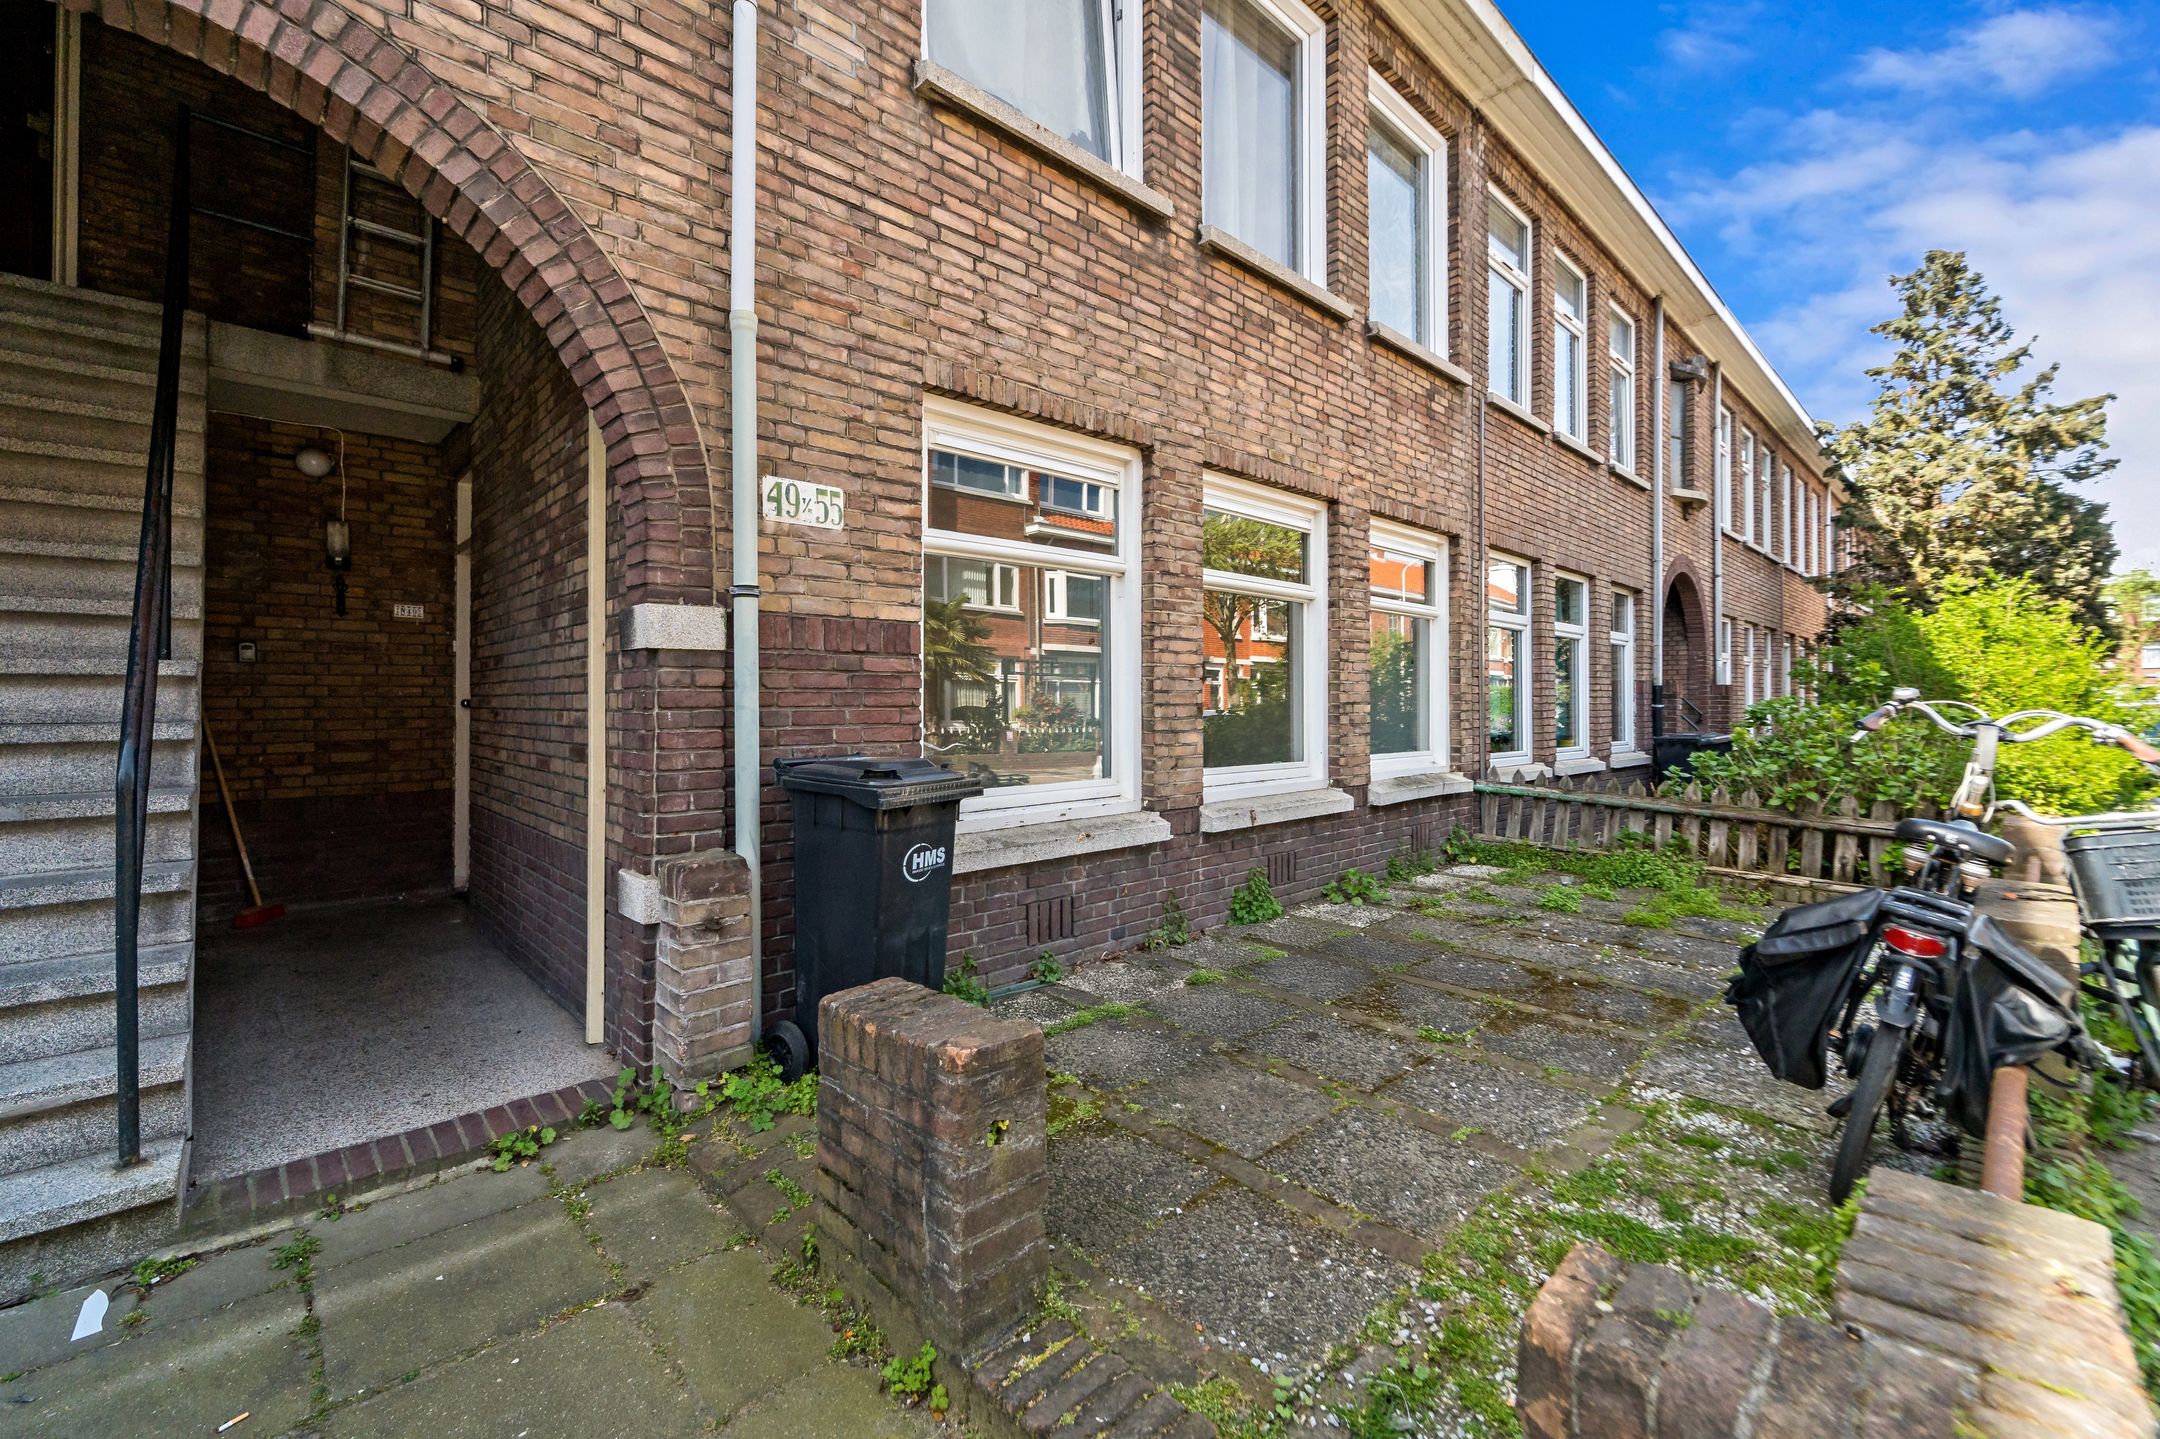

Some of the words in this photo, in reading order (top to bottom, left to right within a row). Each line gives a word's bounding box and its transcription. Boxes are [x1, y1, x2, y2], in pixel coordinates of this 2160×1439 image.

[767, 481, 800, 518] 49
[815, 487, 843, 525] 55
[912, 846, 946, 870] HMS
